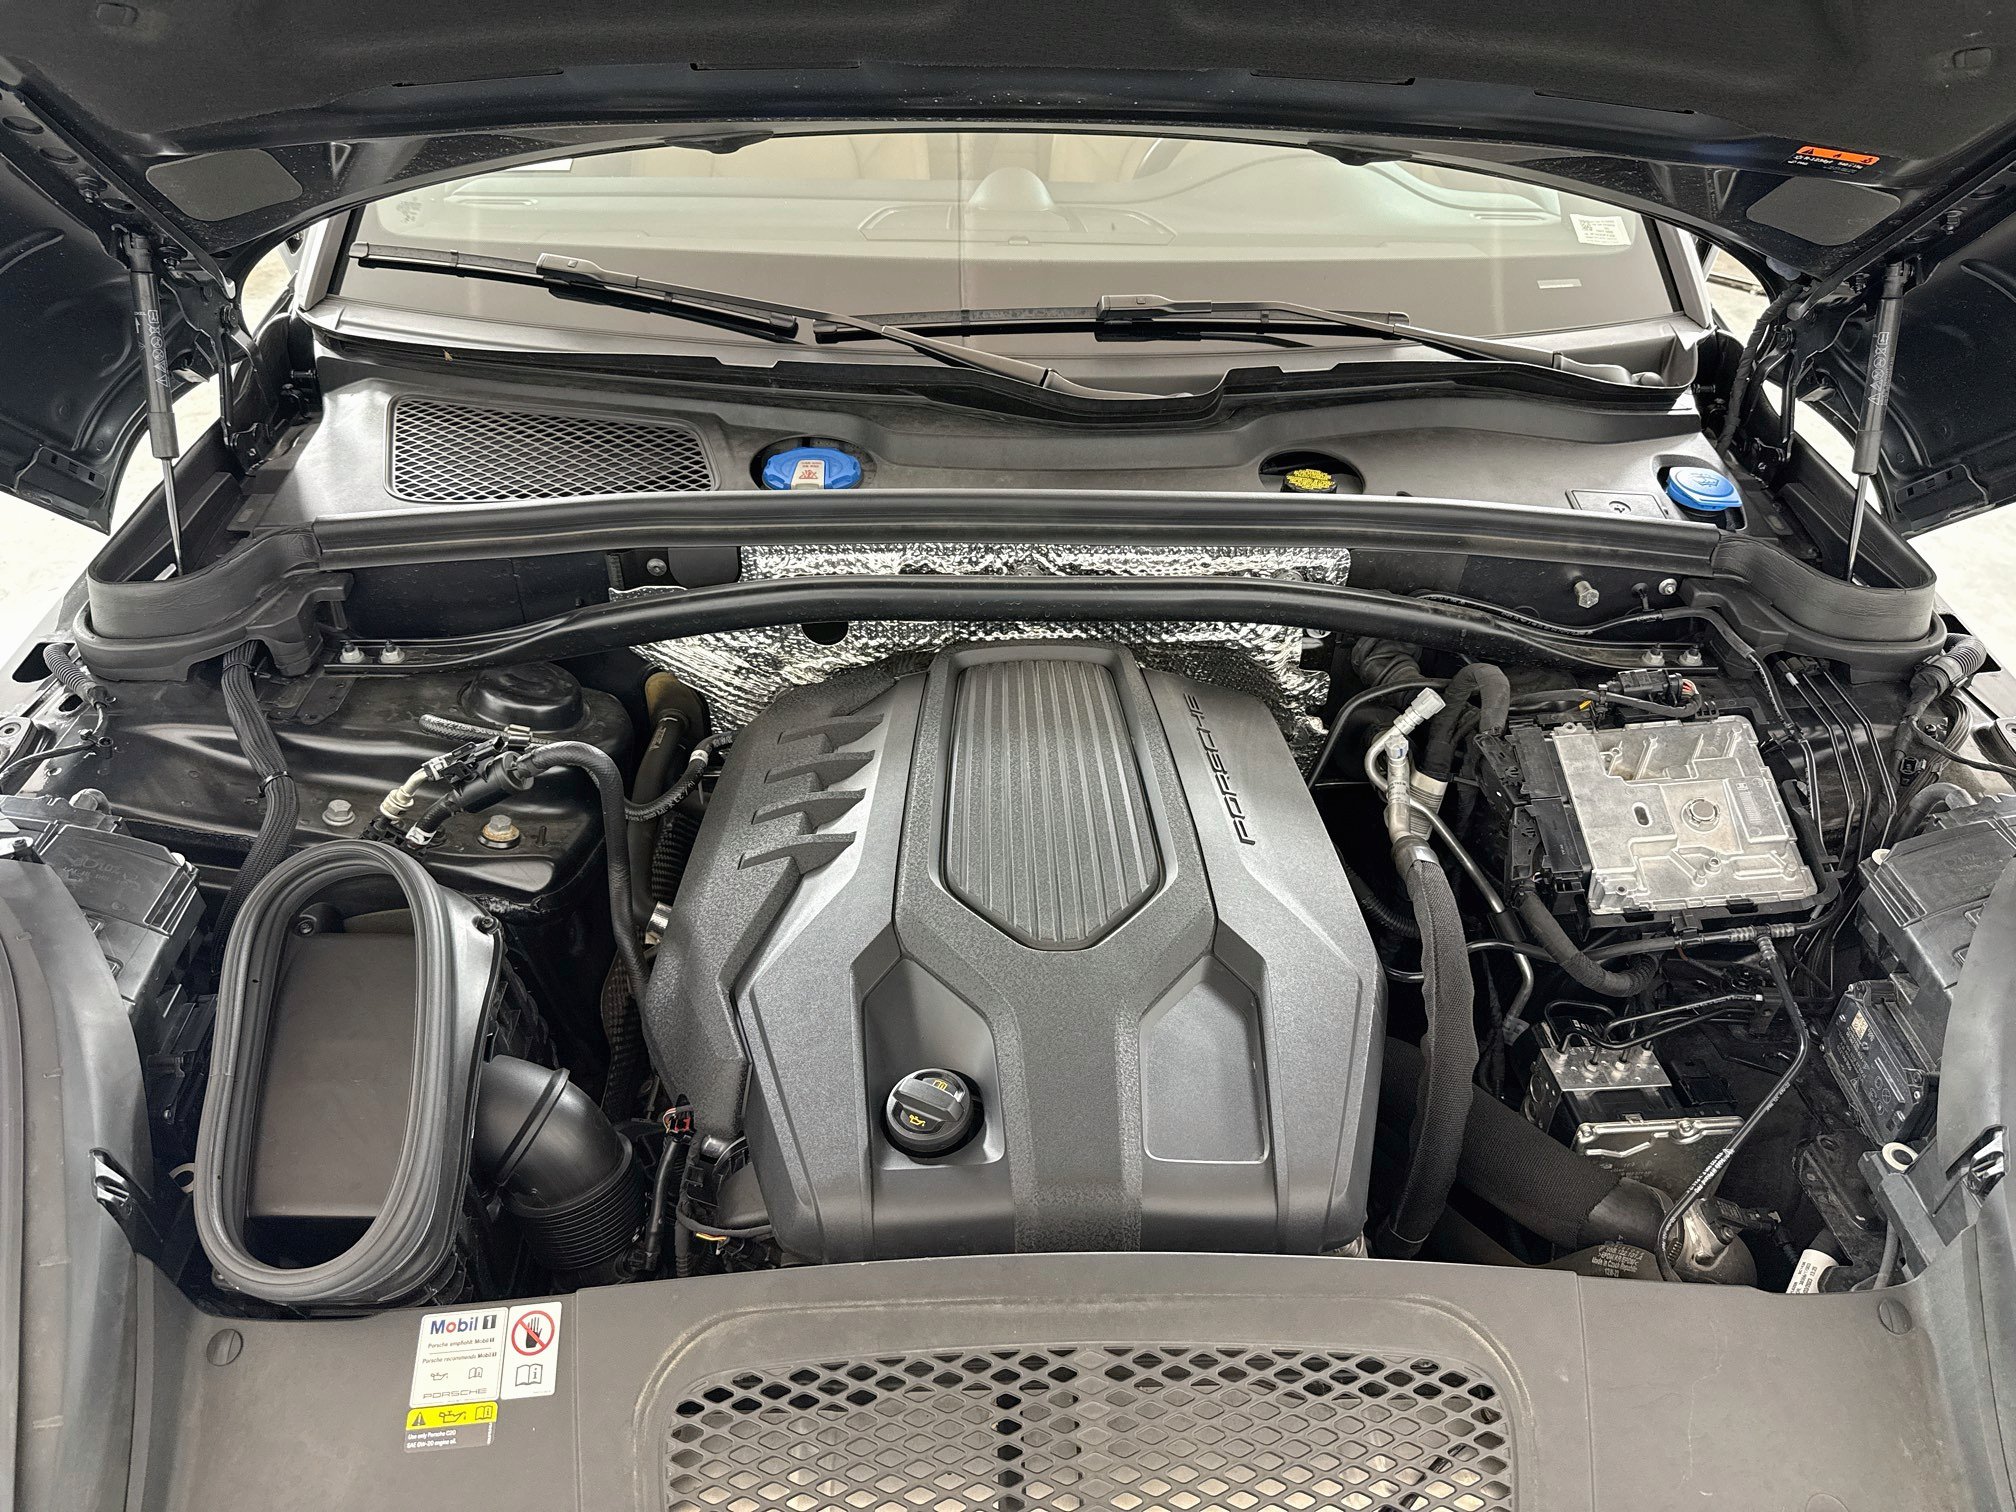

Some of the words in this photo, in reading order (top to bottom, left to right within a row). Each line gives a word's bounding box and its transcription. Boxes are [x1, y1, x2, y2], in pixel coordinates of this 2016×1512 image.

[1183, 692, 1256, 845] PORSCHE
[1591, 1257, 1603, 1266] Made
[1608, 1260, 1620, 1269] Czech
[1620, 1263, 1638, 1272] Republic
[430, 1316, 479, 1335] Mobil
[428, 1340, 449, 1349] Porsche
[422, 1356, 443, 1364] Porsche
[444, 1354, 477, 1362] recommends
[477, 1352, 492, 1360] Mobil
[423, 1388, 488, 1399] PORSCHE
[427, 1430, 446, 1438] Porsche
[406, 1441, 417, 1449] SAE
[434, 1438, 450, 1448] engine
